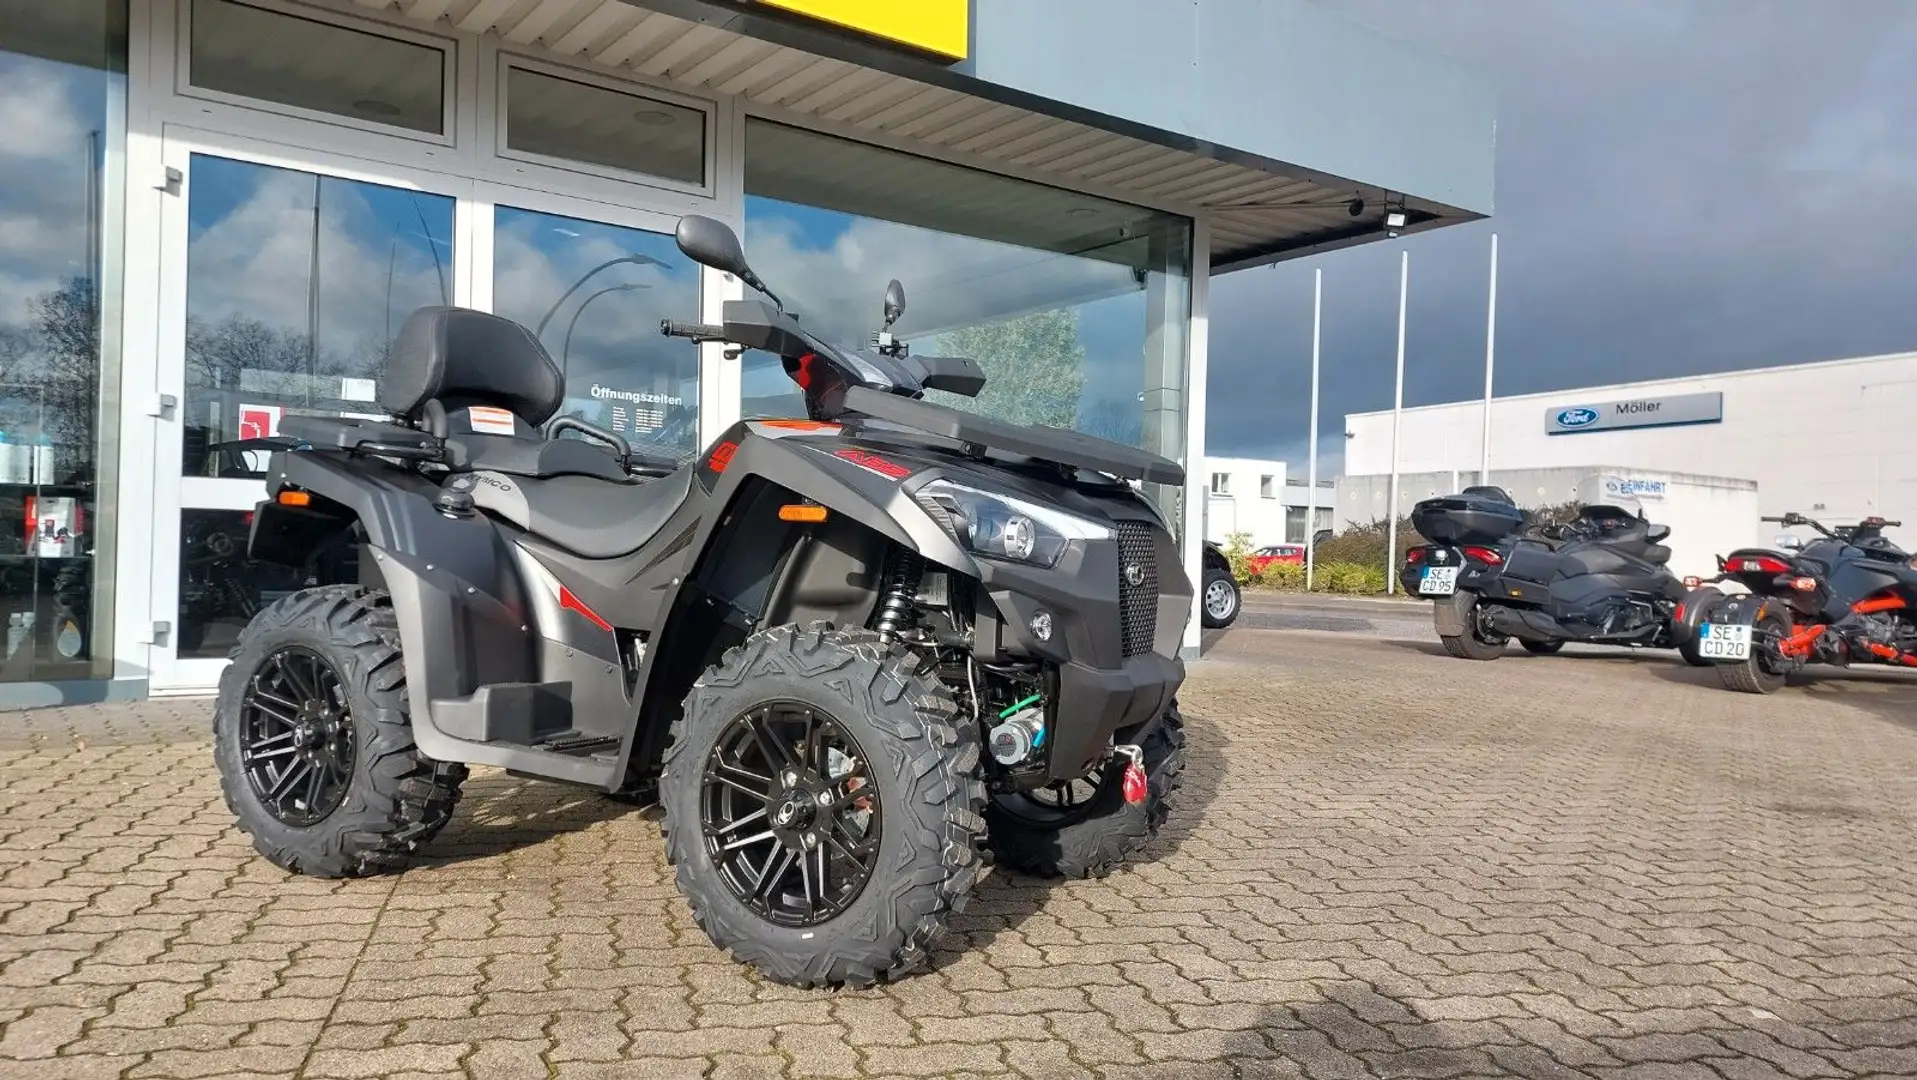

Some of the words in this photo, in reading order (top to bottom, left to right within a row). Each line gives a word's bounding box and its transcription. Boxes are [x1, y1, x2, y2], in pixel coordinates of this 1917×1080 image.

[590, 384, 682, 405] Öffnungszeiten
[1616, 401, 1662, 415] Möller
[1430, 569, 1443, 580] SE
[1422, 580, 1437, 591] CD
[1439, 581, 1451, 592] 95
[1713, 625, 1732, 640] SE
[1704, 641, 1723, 655] CD
[1726, 642, 1745, 656] 20
